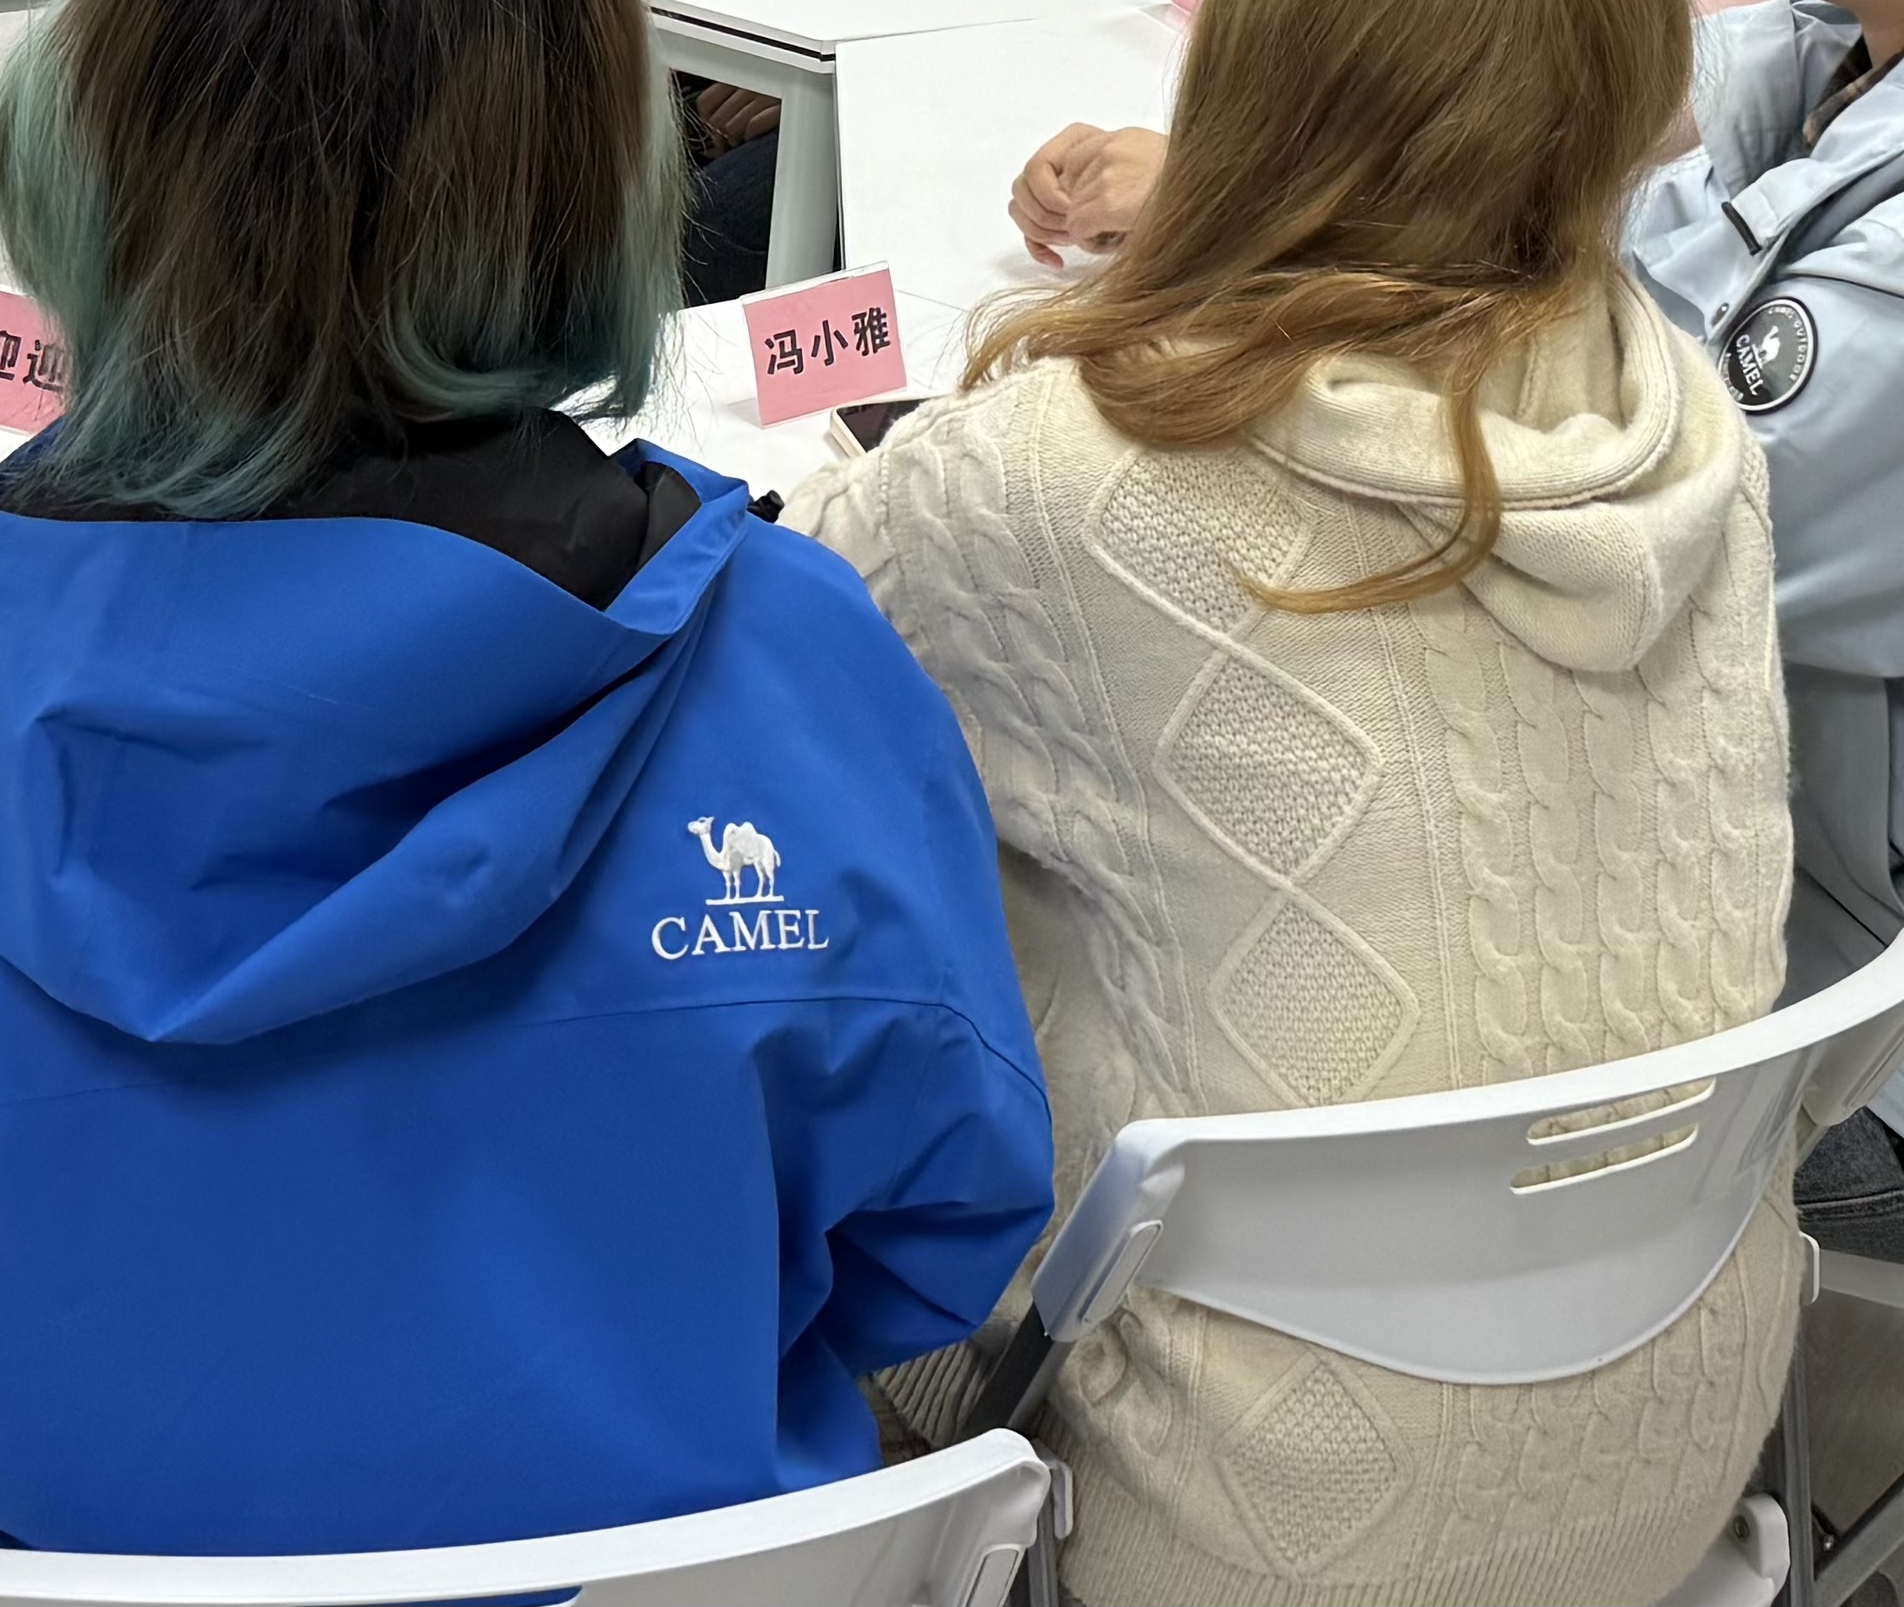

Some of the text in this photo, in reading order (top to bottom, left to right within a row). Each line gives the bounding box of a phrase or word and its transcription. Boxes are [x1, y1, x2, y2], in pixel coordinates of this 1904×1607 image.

[764, 307, 891, 375] 冯小雅
[1737, 334, 1764, 395] CAMEL
[651, 909, 829, 960] CAMEL
